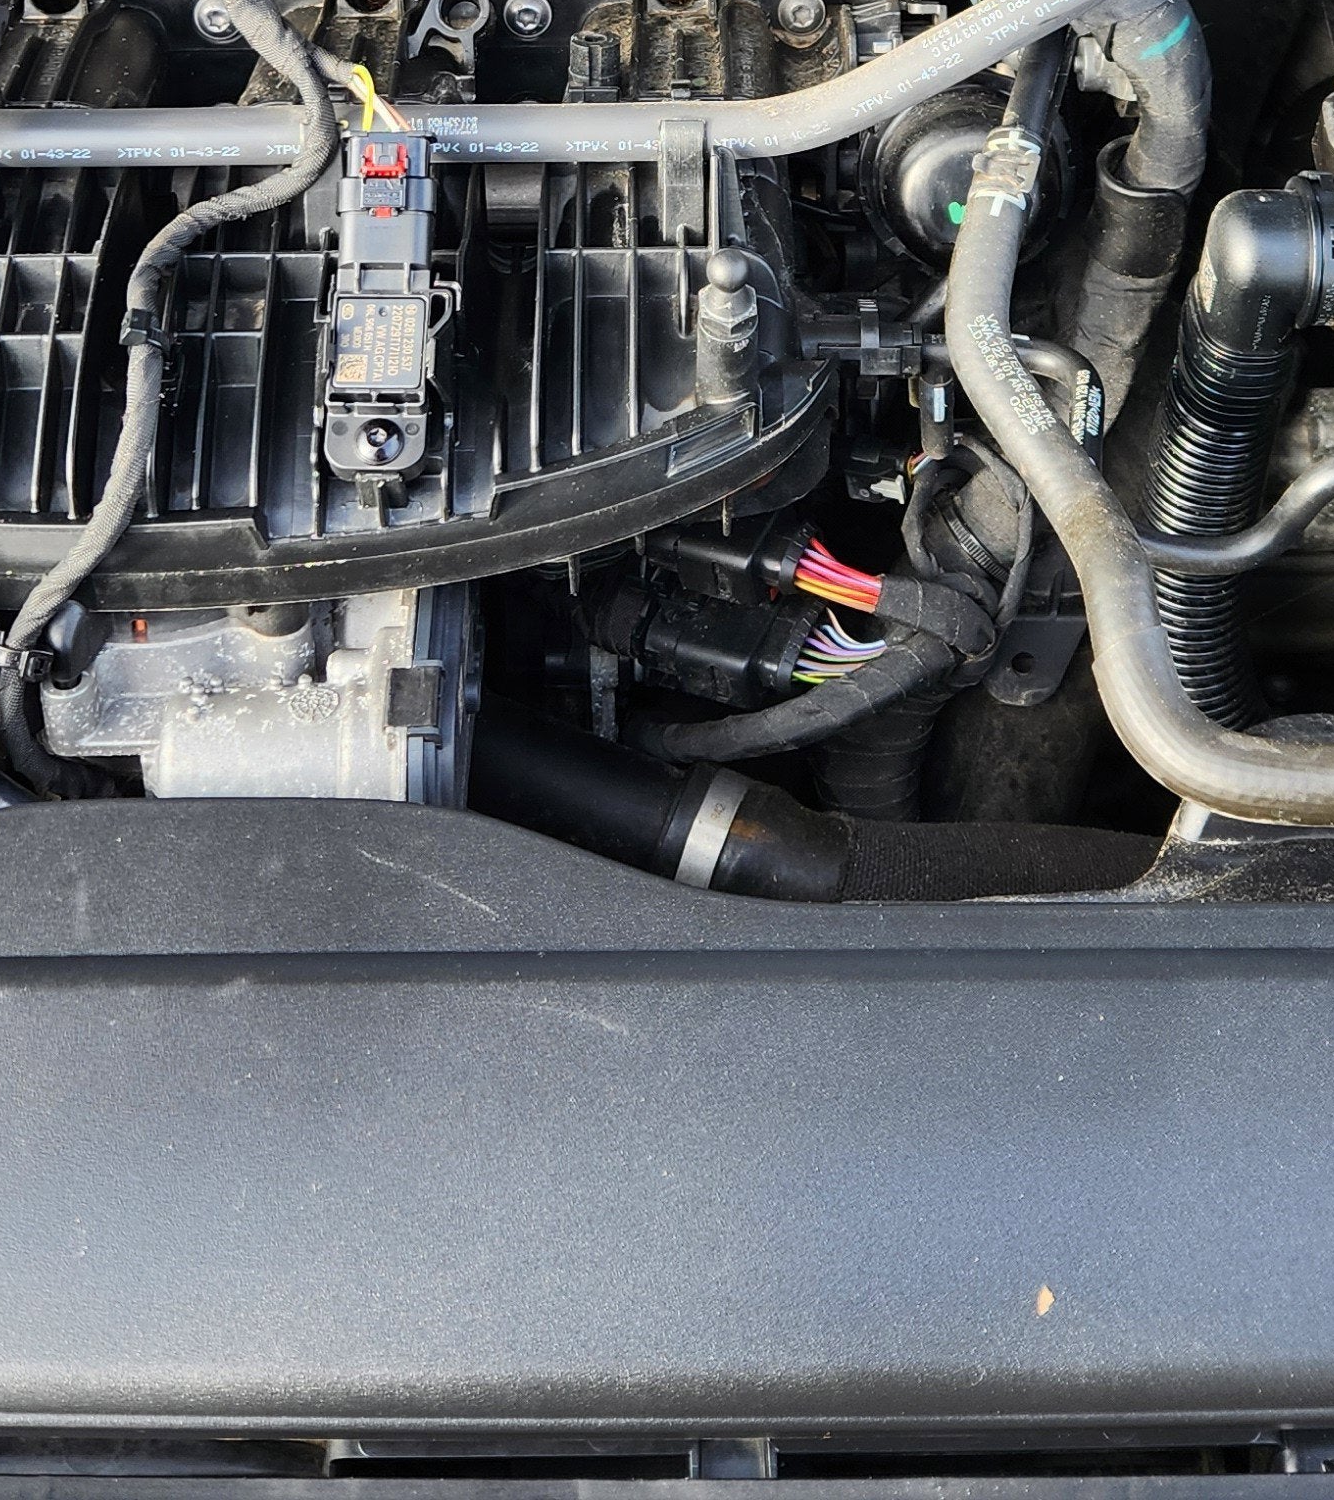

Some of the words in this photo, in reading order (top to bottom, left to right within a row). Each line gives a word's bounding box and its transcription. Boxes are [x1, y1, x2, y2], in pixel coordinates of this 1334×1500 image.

[943, 34, 964, 54] 723
[897, 52, 964, 93] 01-43-22
[20, 149, 92, 160] 01-43-22
[117, 147, 161, 159] >TPV<
[170, 146, 240, 158] 01-43-22
[267, 145, 300, 156] >TPV
[430, 143, 459, 154] PV<
[469, 142, 539, 154] 01-43-22
[566, 140, 608, 152] >TPV<
[618, 141, 659, 151] 01-43
[376, 324, 387, 339] VW
[404, 318, 416, 336] 0261
[375, 340, 386, 354] AG
[402, 338, 414, 354] 230
[974, 315, 995, 340] 5WA
[990, 341, 1005, 359] 122
[1000, 360, 1015, 377] 101
[401, 356, 413, 372] 537
[987, 313, 1003, 335] VW
[996, 336, 1012, 353] AG
[1007, 355, 1036, 393] TEKLAS
[1031, 392, 1046, 408] RS
[1009, 396, 1038, 435] 02/23
